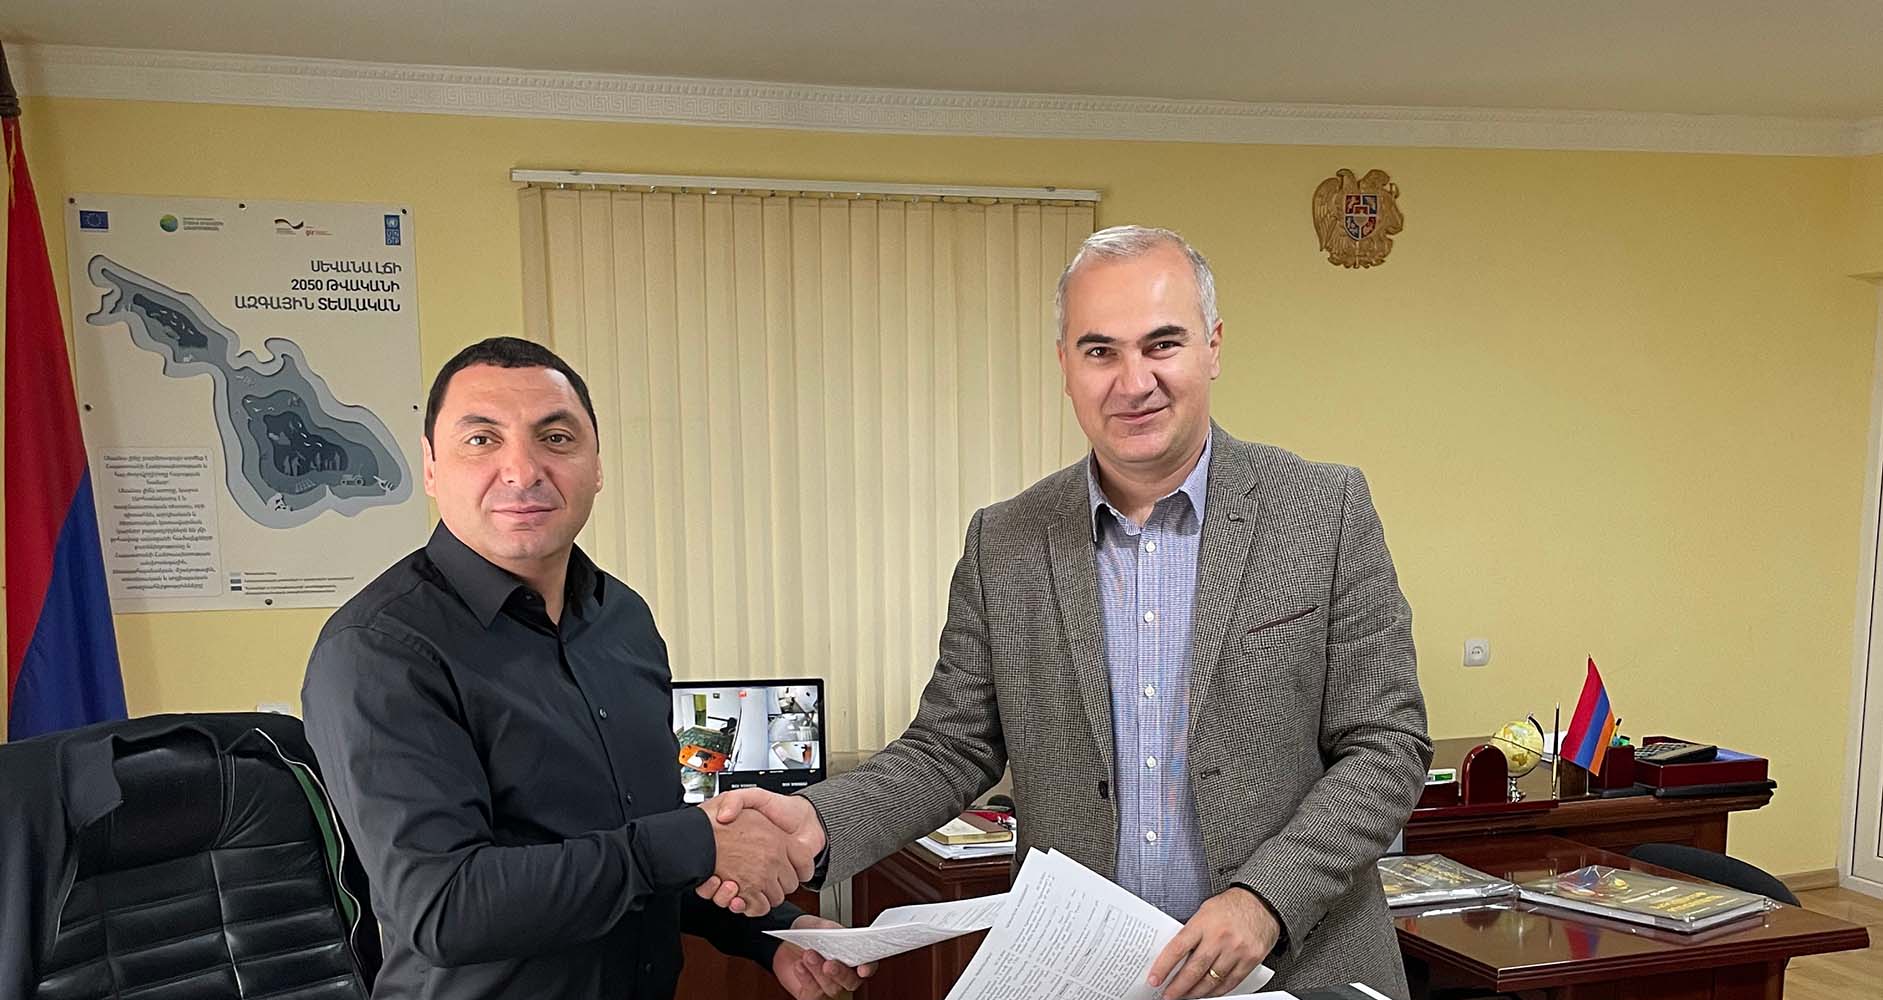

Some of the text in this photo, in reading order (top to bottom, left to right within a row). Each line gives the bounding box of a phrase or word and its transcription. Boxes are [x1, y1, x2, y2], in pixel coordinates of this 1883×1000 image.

[311, 260, 401, 274] ՍԵՎԱՆԱ ԼՃԻ
[291, 279, 400, 292] 2050 ԹՎԱԿԱՆԻ
[235, 296, 400, 312] ԱԶԳԱՅԻՆ ՏԵՍԼԱԿԱՆ
